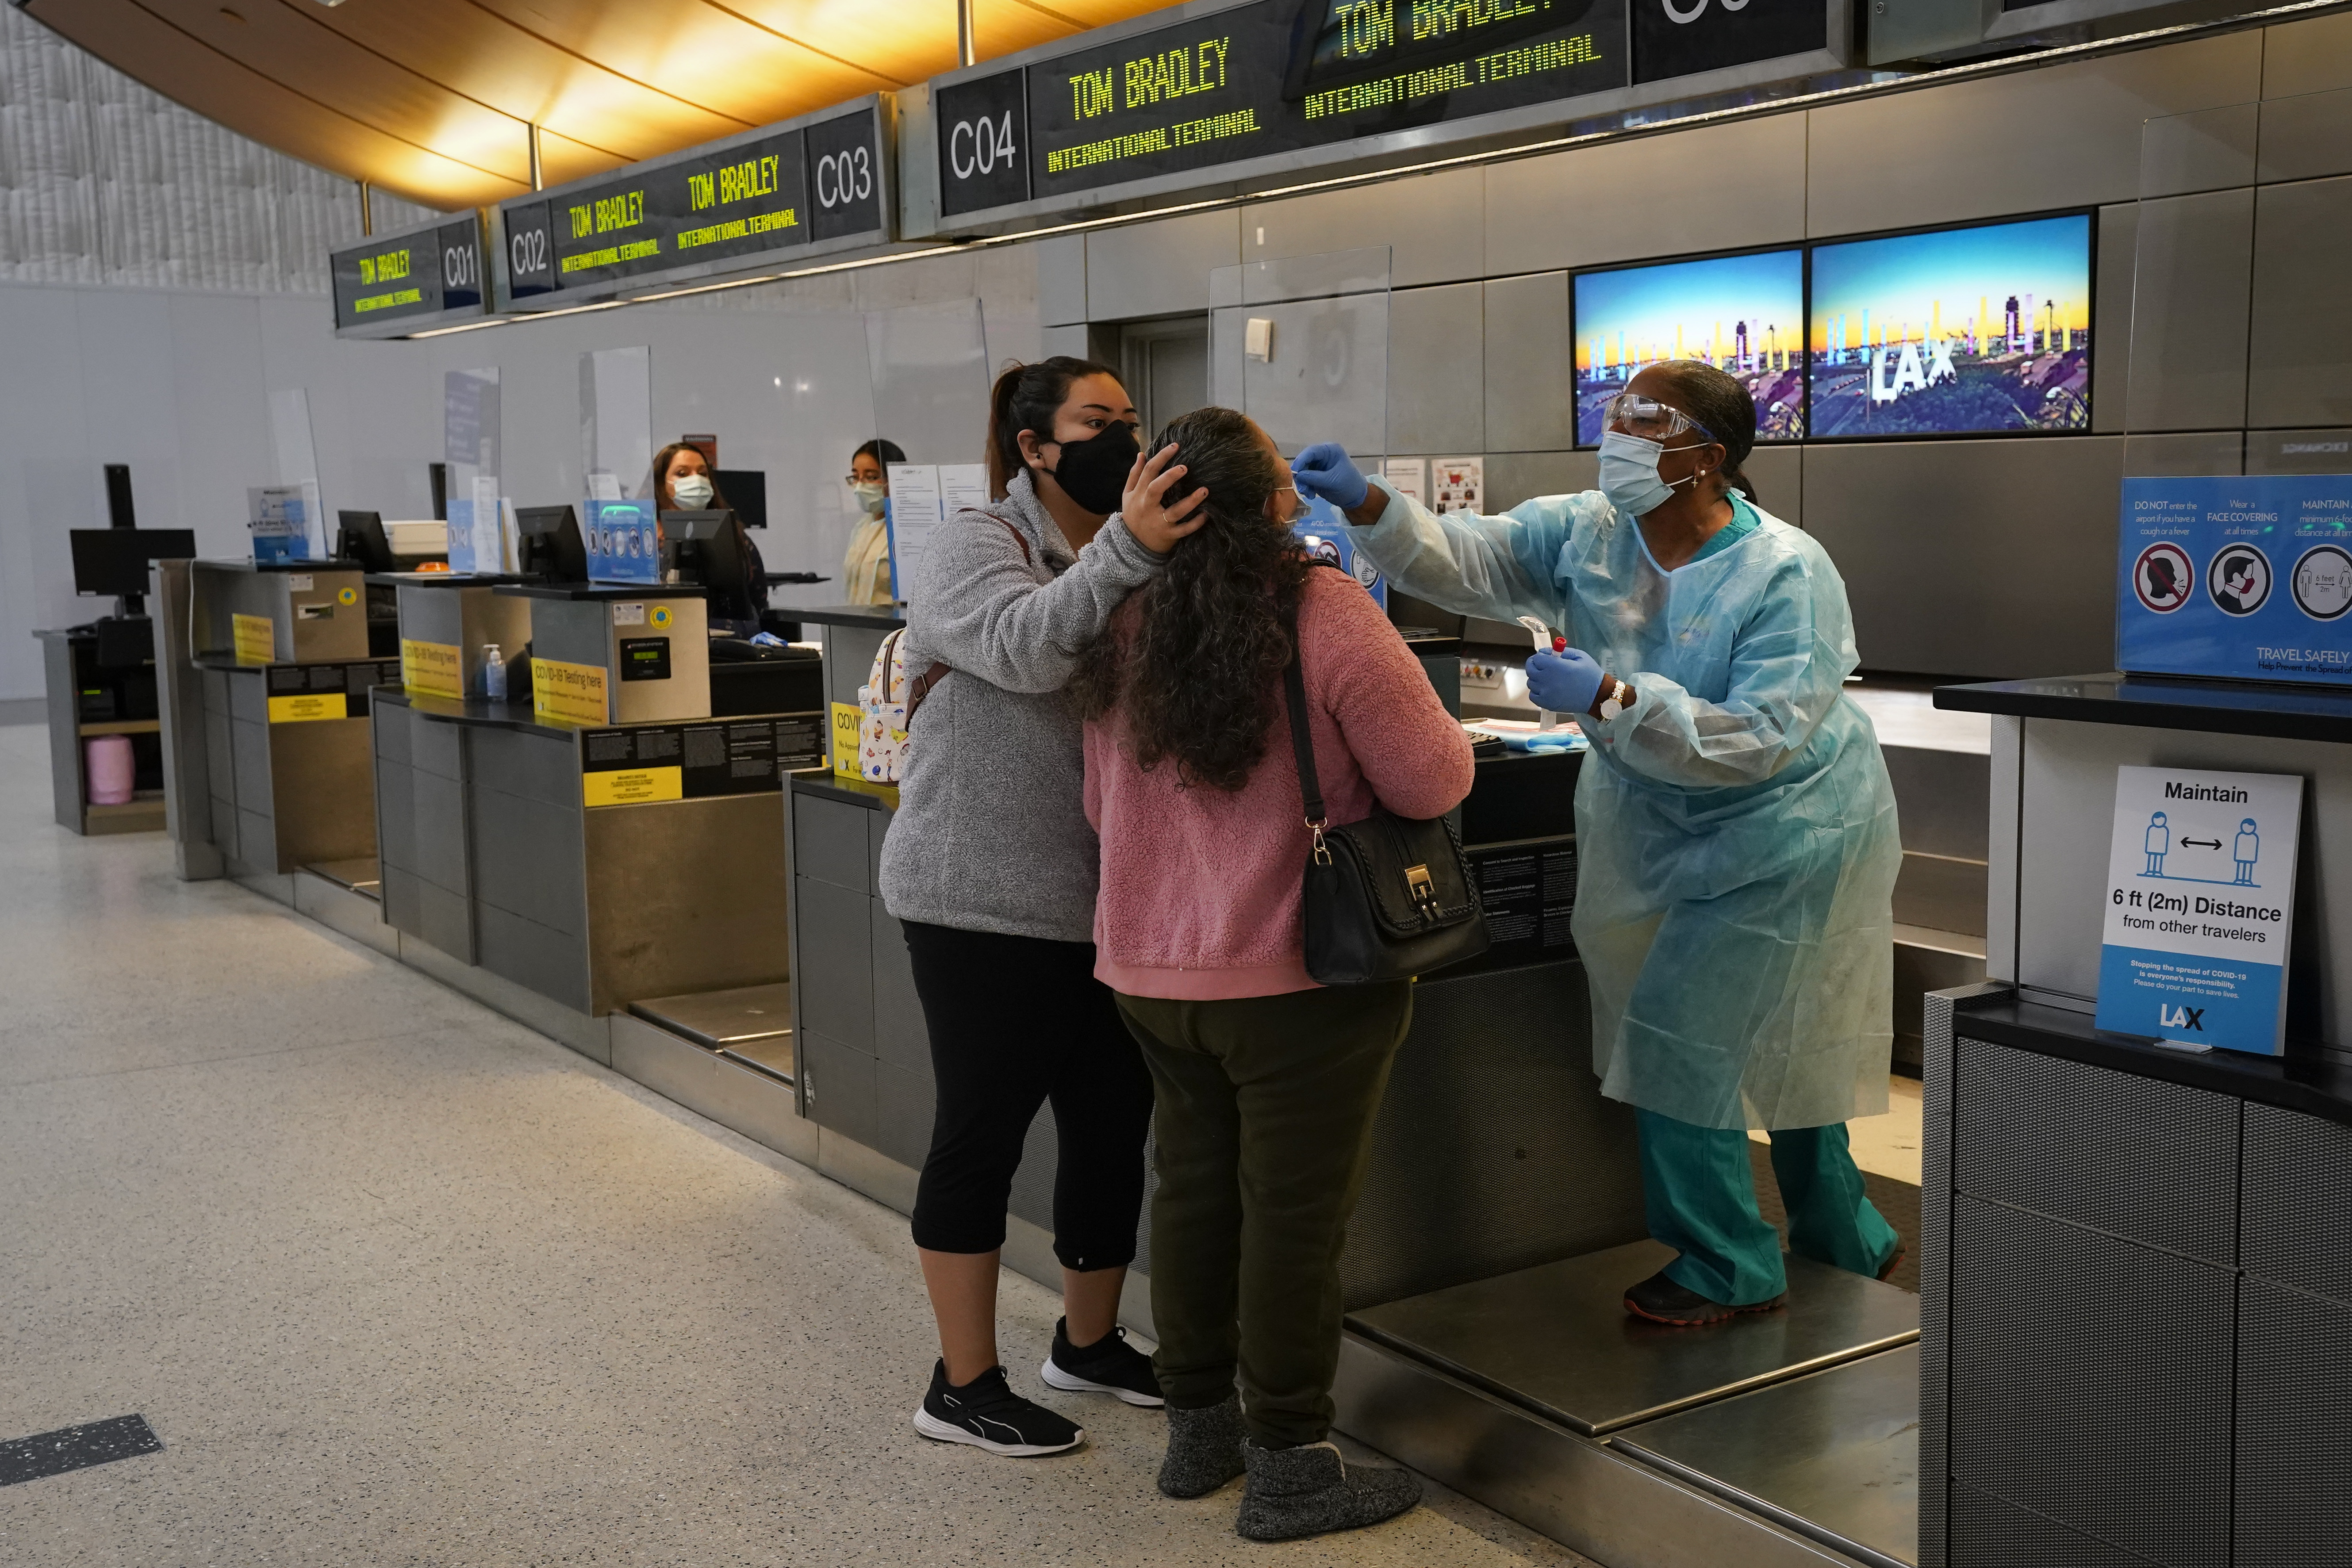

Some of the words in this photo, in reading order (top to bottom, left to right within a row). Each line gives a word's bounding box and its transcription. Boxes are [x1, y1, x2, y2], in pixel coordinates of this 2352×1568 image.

[1335, 6, 1394, 57] TOM
[1069, 67, 1113, 120] TOM
[1125, 37, 1229, 109] BRADLEY
[1305, 63, 1474, 119] INTERNATIONAL
[1475, 34, 1601, 83] TERMINAL
[950, 109, 1016, 180] C04
[1048, 127, 1172, 173] INTERNATIONAL
[1171, 108, 1261, 146] TERMINAL
[687, 172, 715, 211] TOM
[719, 154, 779, 204] BRADLEY
[817, 146, 871, 208] C03
[569, 203, 593, 239] TOM
[595, 190, 644, 233] BRADLEY
[677, 219, 749, 249] INTERNATIONAL
[748, 208, 799, 234] TERMINAL
[512, 228, 547, 275] C02
[445, 244, 475, 288] C01
[1872, 337, 1957, 402] LAX
[2135, 501, 2149, 510] DO
[2149, 501, 2168, 510] NOT
[2187, 501, 2198, 510] the
[2207, 513, 2229, 521] FACE
[2230, 513, 2278, 522] COVERING
[2230, 499, 2248, 508] Wear
[2302, 500, 2349, 509] MAINTAIN
[2136, 515, 2156, 524] airport
[2156, 514, 2161, 522] if
[2175, 514, 2190, 522] have
[2140, 526, 2160, 537] cough
[2174, 526, 2190, 535] fever
[2295, 527, 2324, 537] distance
[2256, 647, 2303, 661] TRAVEL
[2305, 651, 2350, 663] SAFELY
[2258, 661, 2275, 672] Help
[2276, 663, 2302, 671] Prevent
[2305, 663, 2317, 672] the
[2318, 664, 2343, 676] Spread
[2344, 665, 2352, 674] of
[837, 713, 860, 732] COVI
[2165, 782, 2248, 803] Maintain
[2113, 889, 2124, 905] 6
[2129, 891, 2142, 907] ft
[2148, 893, 2188, 916] (2m)
[2195, 897, 2281, 922] Distance
[2123, 914, 2155, 930] from
[2159, 920, 2198, 935] other
[2202, 926, 2266, 943] travelers
[2130, 959, 2161, 971] Stopping
[2163, 963, 2174, 972] the
[2176, 966, 2200, 975] spread
[2212, 970, 2247, 981] COVID-19
[2147, 973, 2184, 982] everyone's
[2186, 977, 2236, 990] responsibility.
[2133, 978, 2155, 988] Please
[2182, 985, 2196, 993] part
[2223, 990, 2240, 999] lives.
[2160, 1003, 2205, 1031] LAX
